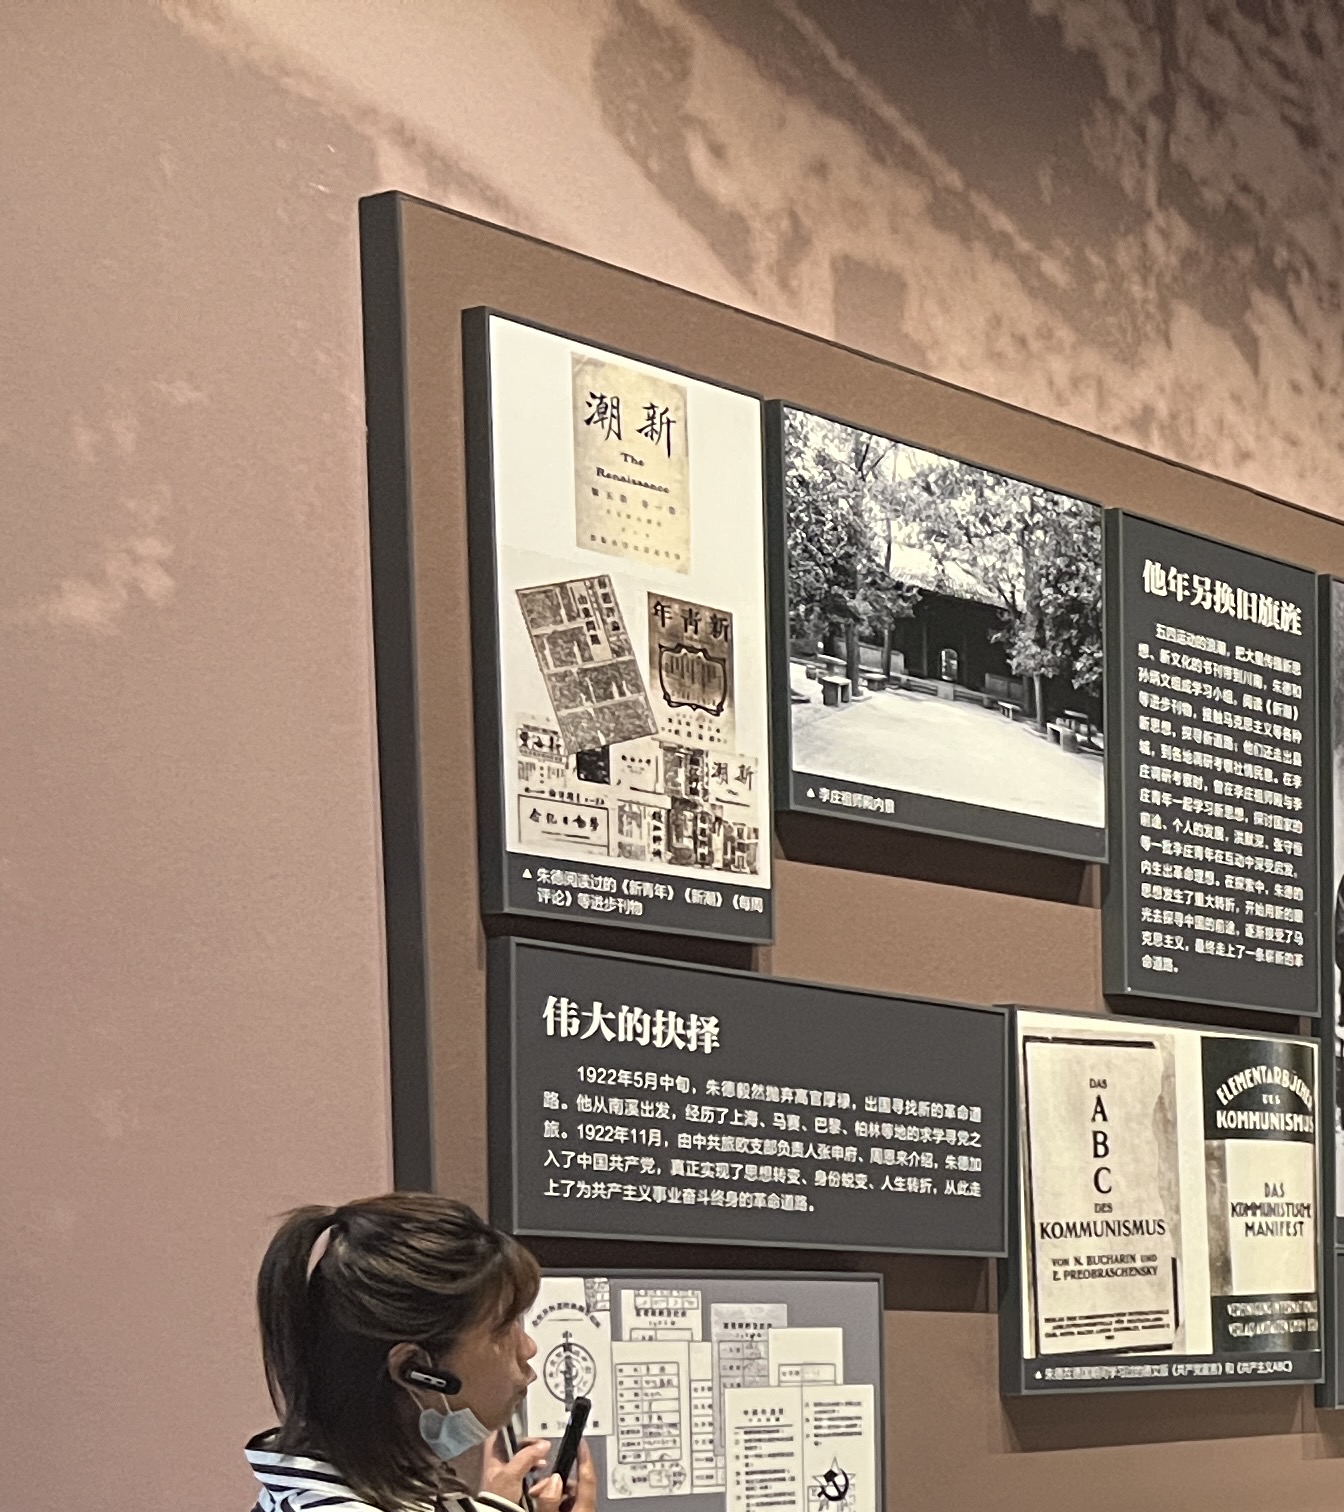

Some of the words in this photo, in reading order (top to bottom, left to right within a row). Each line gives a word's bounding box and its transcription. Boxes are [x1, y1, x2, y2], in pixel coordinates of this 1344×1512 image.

[620, 452, 645, 467] The
[543, 995, 720, 1054] 伟大的抉择
[1089, 1078, 1108, 1090] DAS
[1090, 1095, 1109, 1123] A
[1092, 1131, 1110, 1159] B
[1094, 1166, 1113, 1195] C
[1264, 1182, 1285, 1199] DAS
[1094, 1202, 1113, 1214] DES
[1039, 1218, 1166, 1240] KOMMUNISMUS
[1244, 1221, 1305, 1238] MANIFEST
